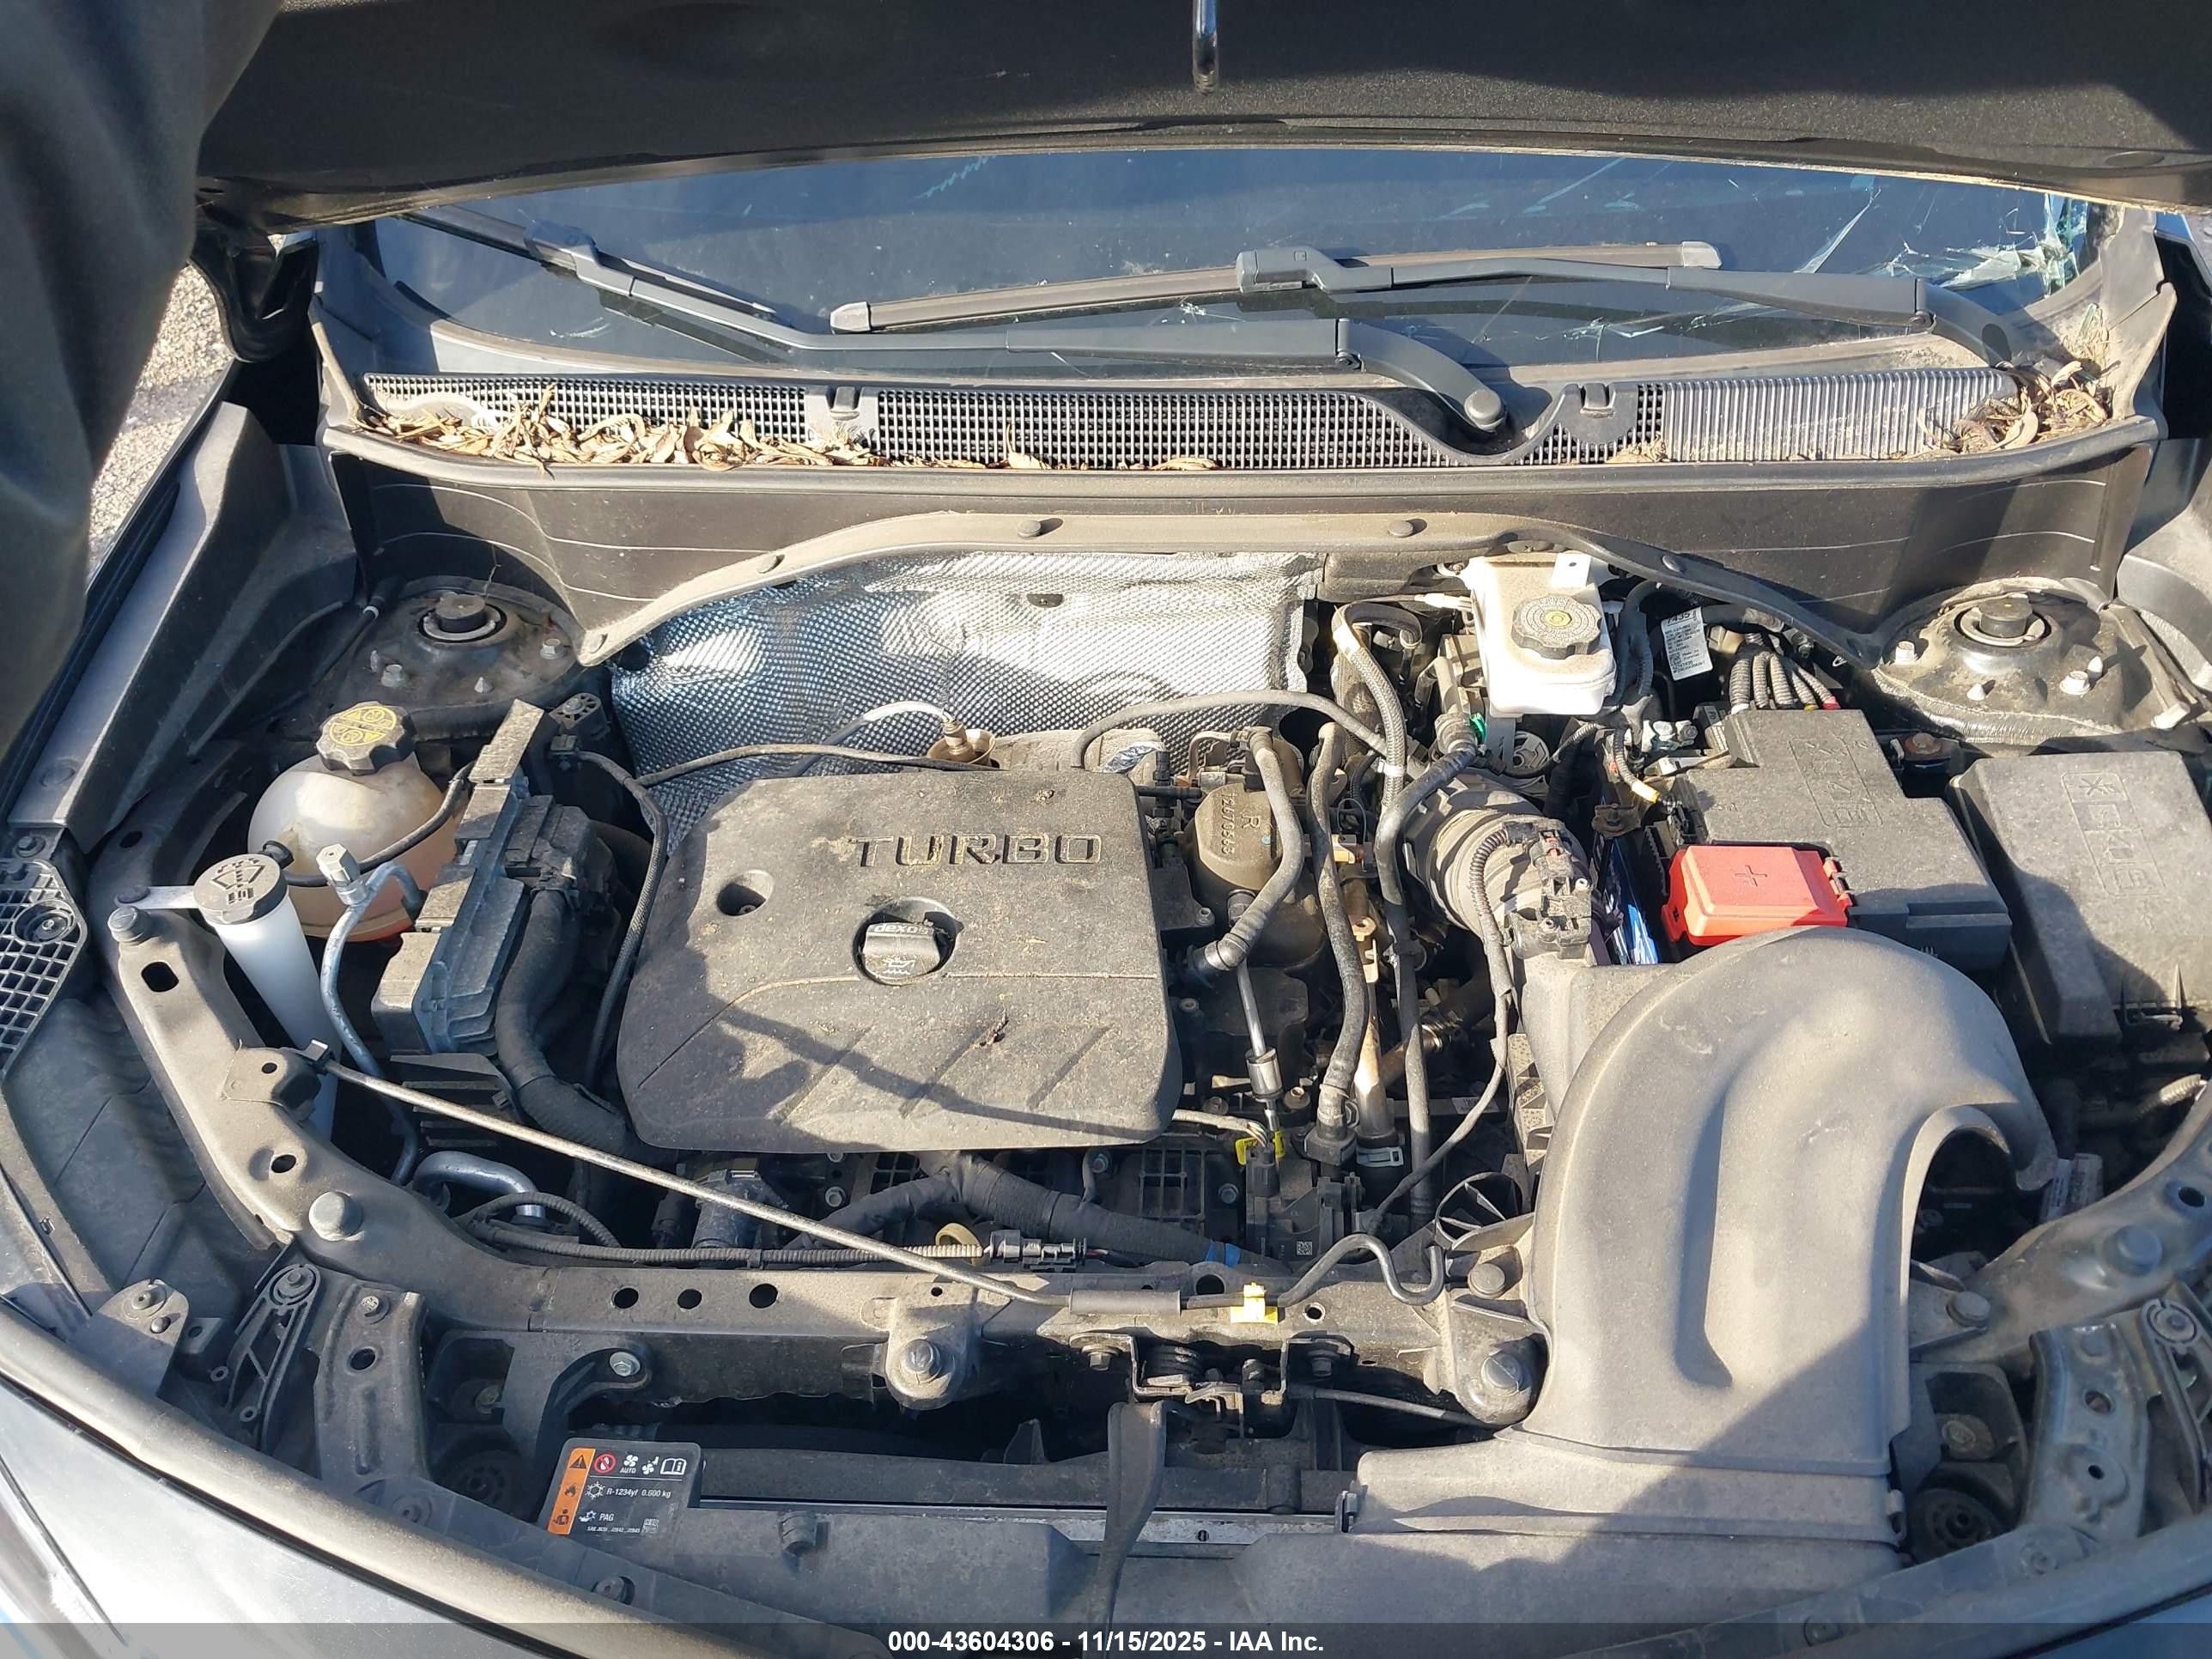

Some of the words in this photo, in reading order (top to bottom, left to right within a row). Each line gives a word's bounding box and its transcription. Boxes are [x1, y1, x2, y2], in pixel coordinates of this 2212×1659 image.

[856, 833, 1102, 867] TURBO
[874, 923, 929, 935] dexos
[606, 1487, 639, 1498] R-1234yf
[662, 1490, 672, 1498] kg
[599, 1513, 615, 1522] PAG
